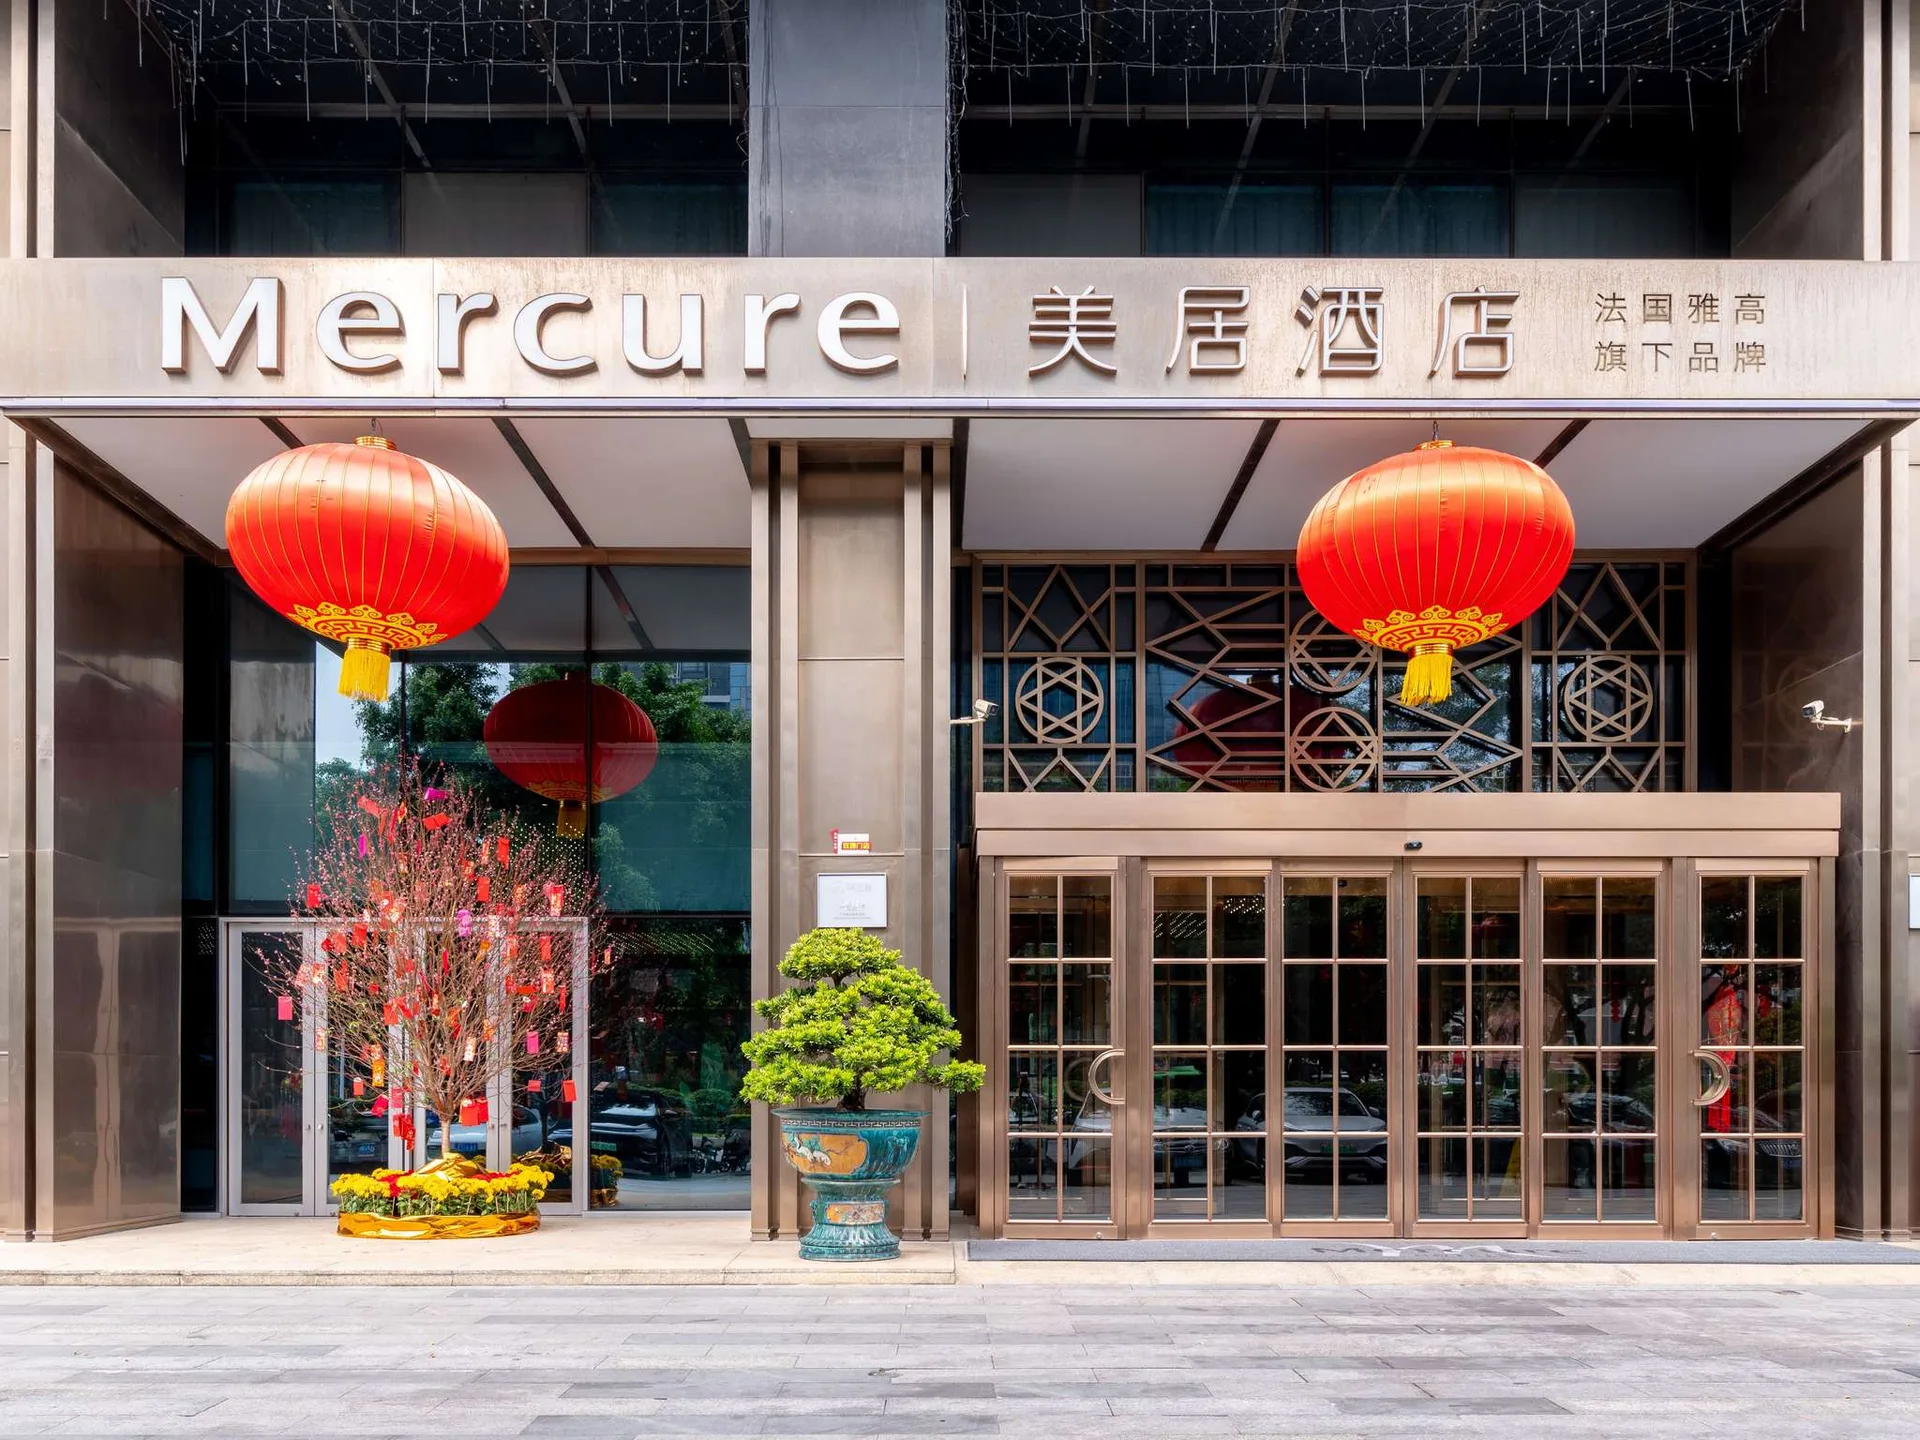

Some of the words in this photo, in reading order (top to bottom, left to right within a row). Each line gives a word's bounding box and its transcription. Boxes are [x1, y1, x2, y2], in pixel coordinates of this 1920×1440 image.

[161, 276, 901, 376] Mercure
[1028, 285, 1520, 378] 美居酒店
[1595, 292, 1766, 325] 法国雅高
[1594, 341, 1767, 373] 旗下品牌
